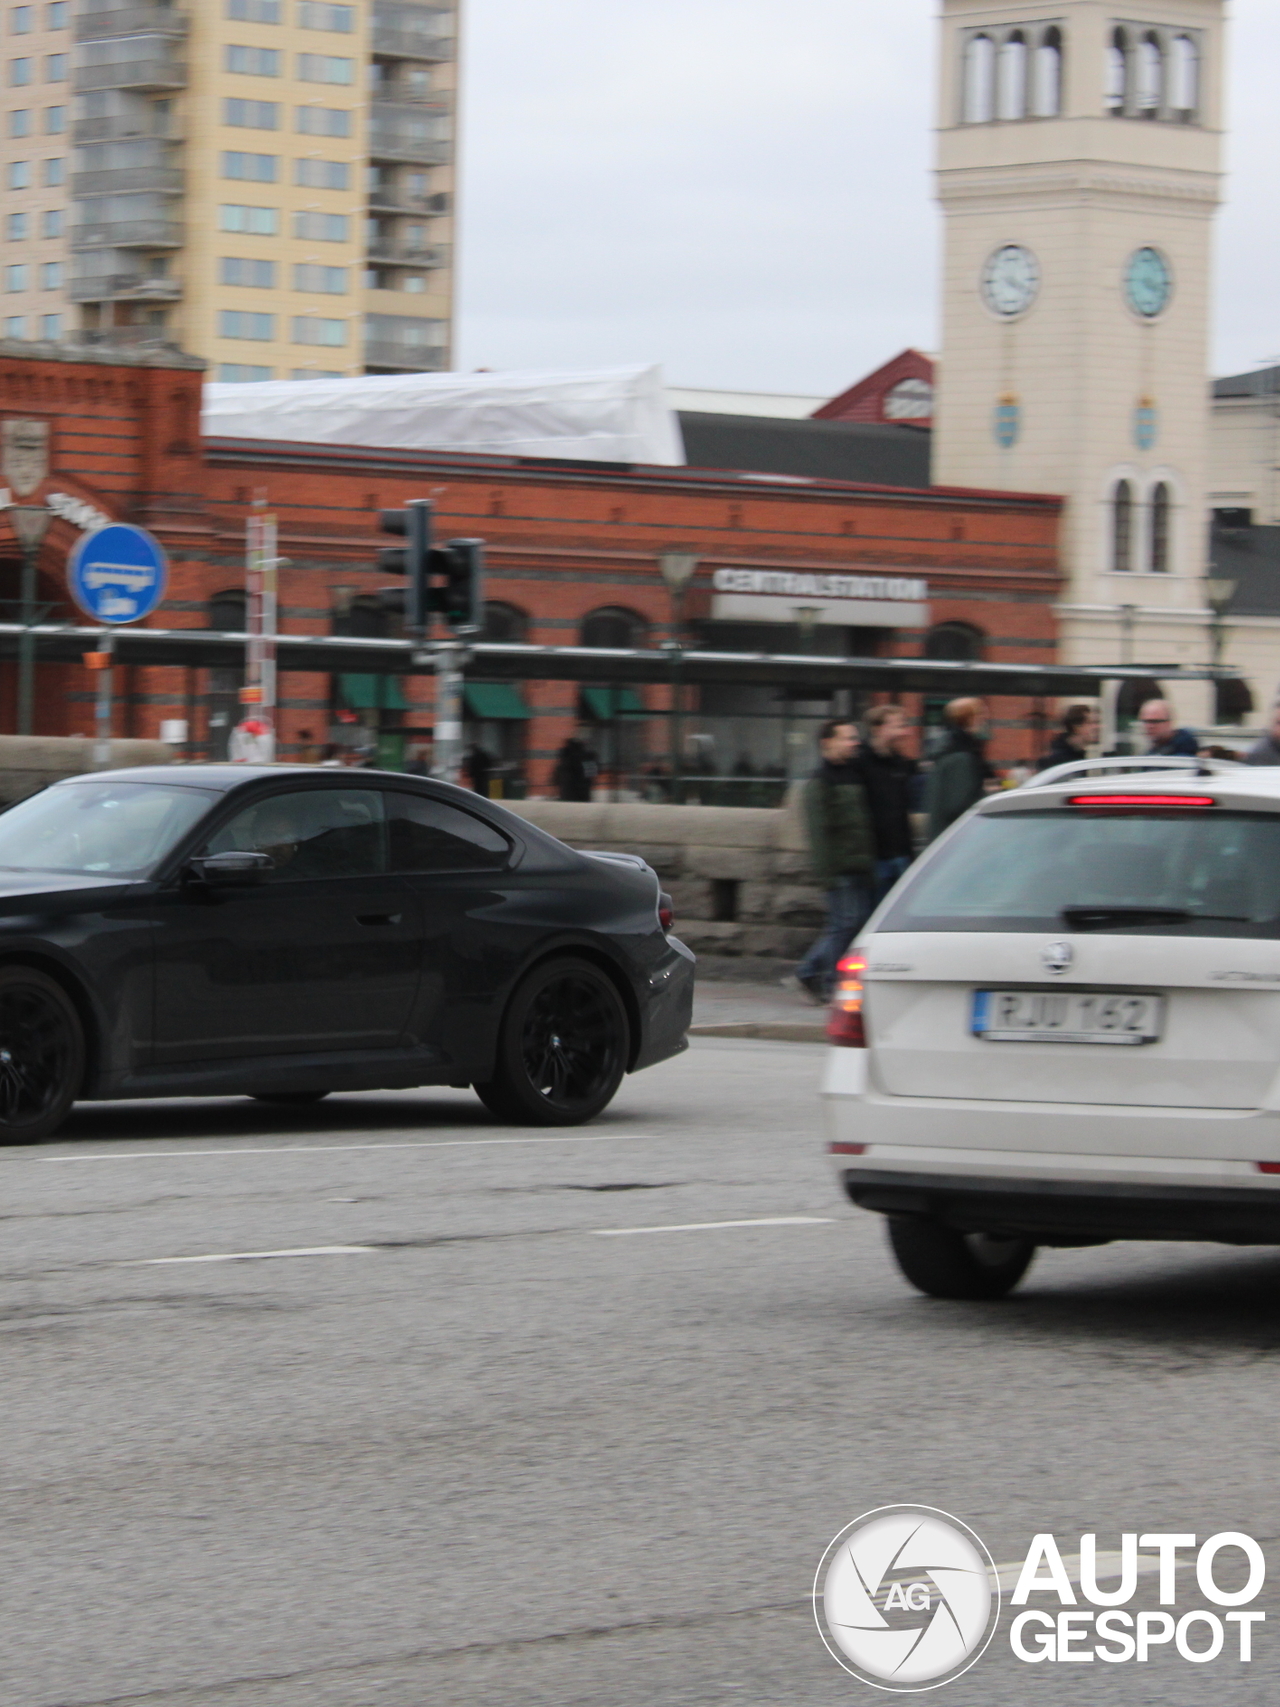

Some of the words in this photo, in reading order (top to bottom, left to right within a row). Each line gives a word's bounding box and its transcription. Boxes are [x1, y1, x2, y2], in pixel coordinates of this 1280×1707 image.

[713, 568, 928, 600] CENTRALSTATION
[996, 996, 1070, 1029] RJU
[1080, 999, 1148, 1032] 162
